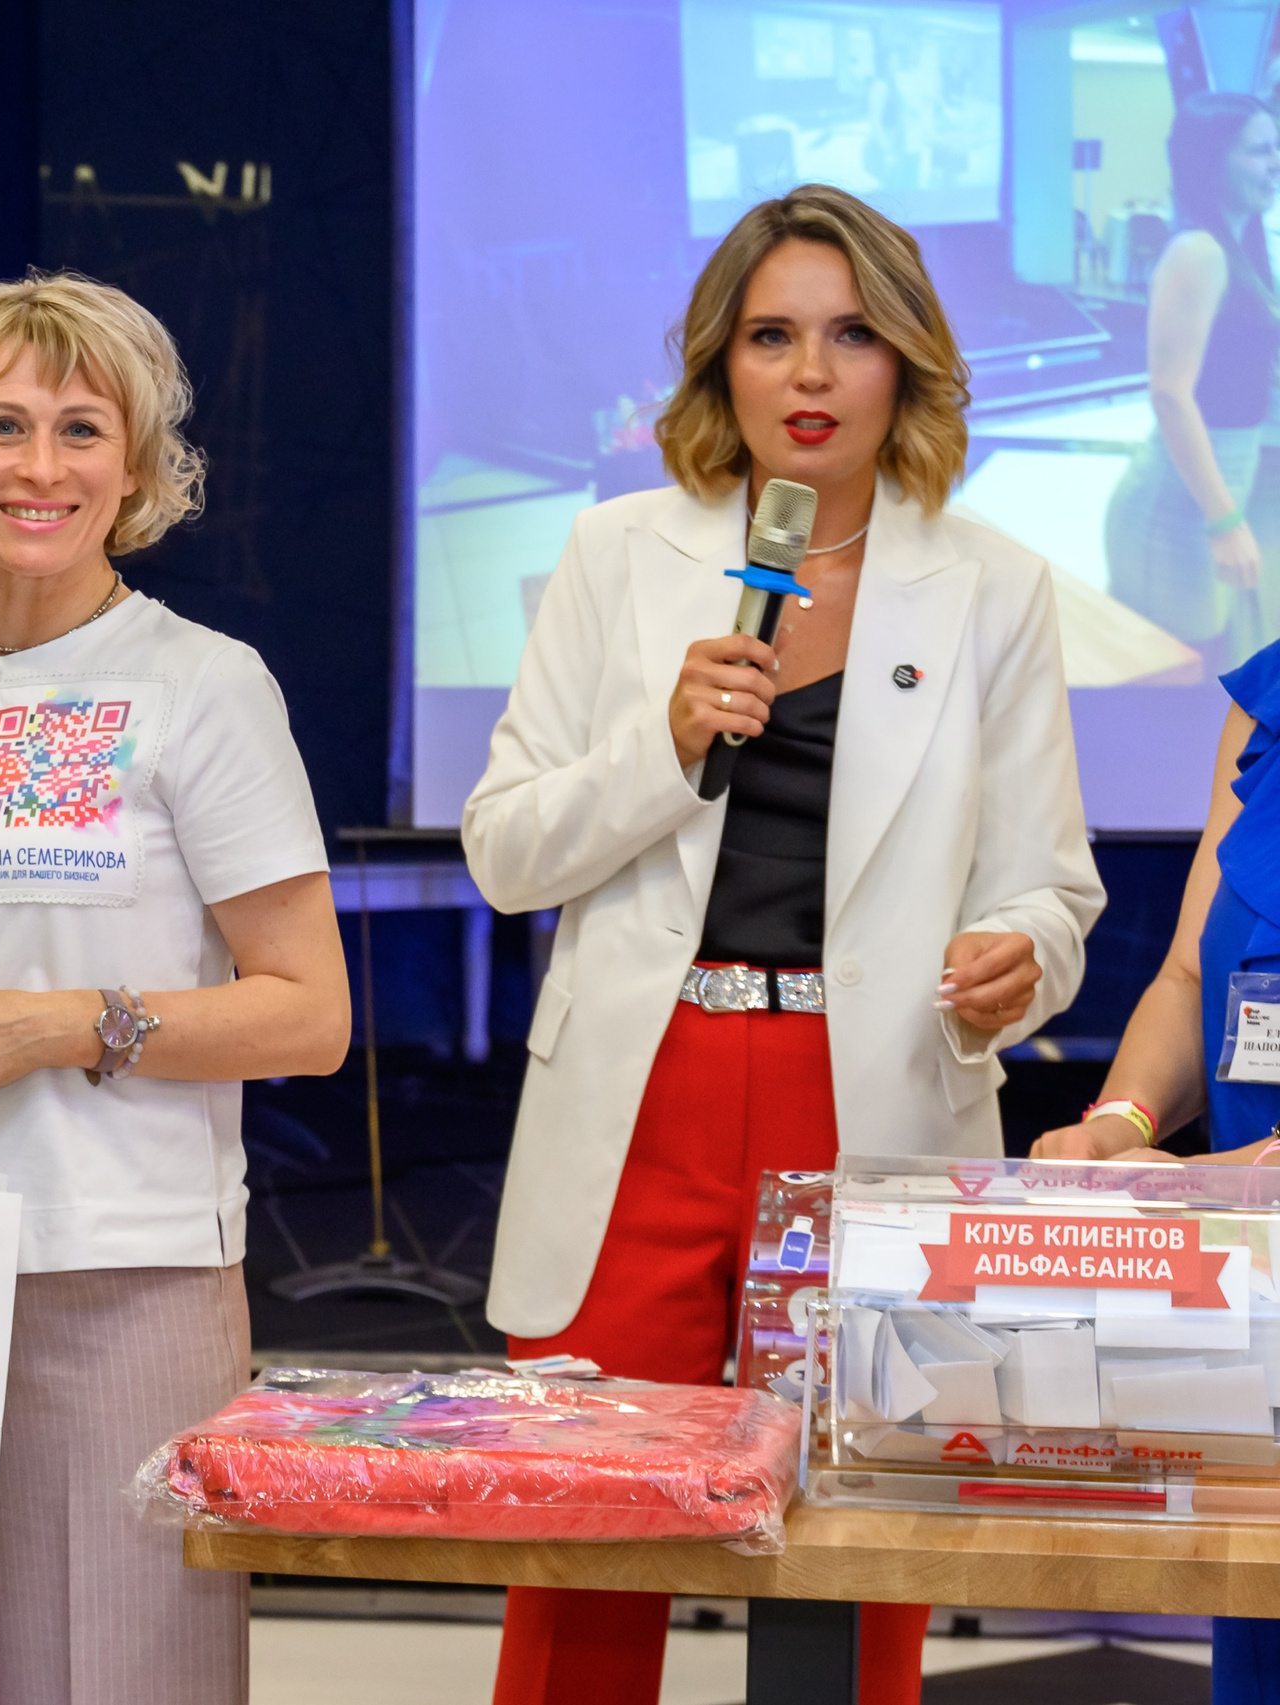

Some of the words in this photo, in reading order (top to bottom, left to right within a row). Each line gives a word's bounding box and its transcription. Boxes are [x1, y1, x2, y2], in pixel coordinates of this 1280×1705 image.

[17, 848, 126, 869] СЕМЕРИКОВА
[12, 870, 27, 880] ДЛЯ
[29, 870, 62, 880] ВАШЕГО
[64, 871, 100, 882] БИЗНЕСА
[965, 1222, 1034, 1246] КЛУБ
[1044, 1224, 1185, 1250] КЛИЕНТОВ
[1014, 1457, 1048, 1465] Для
